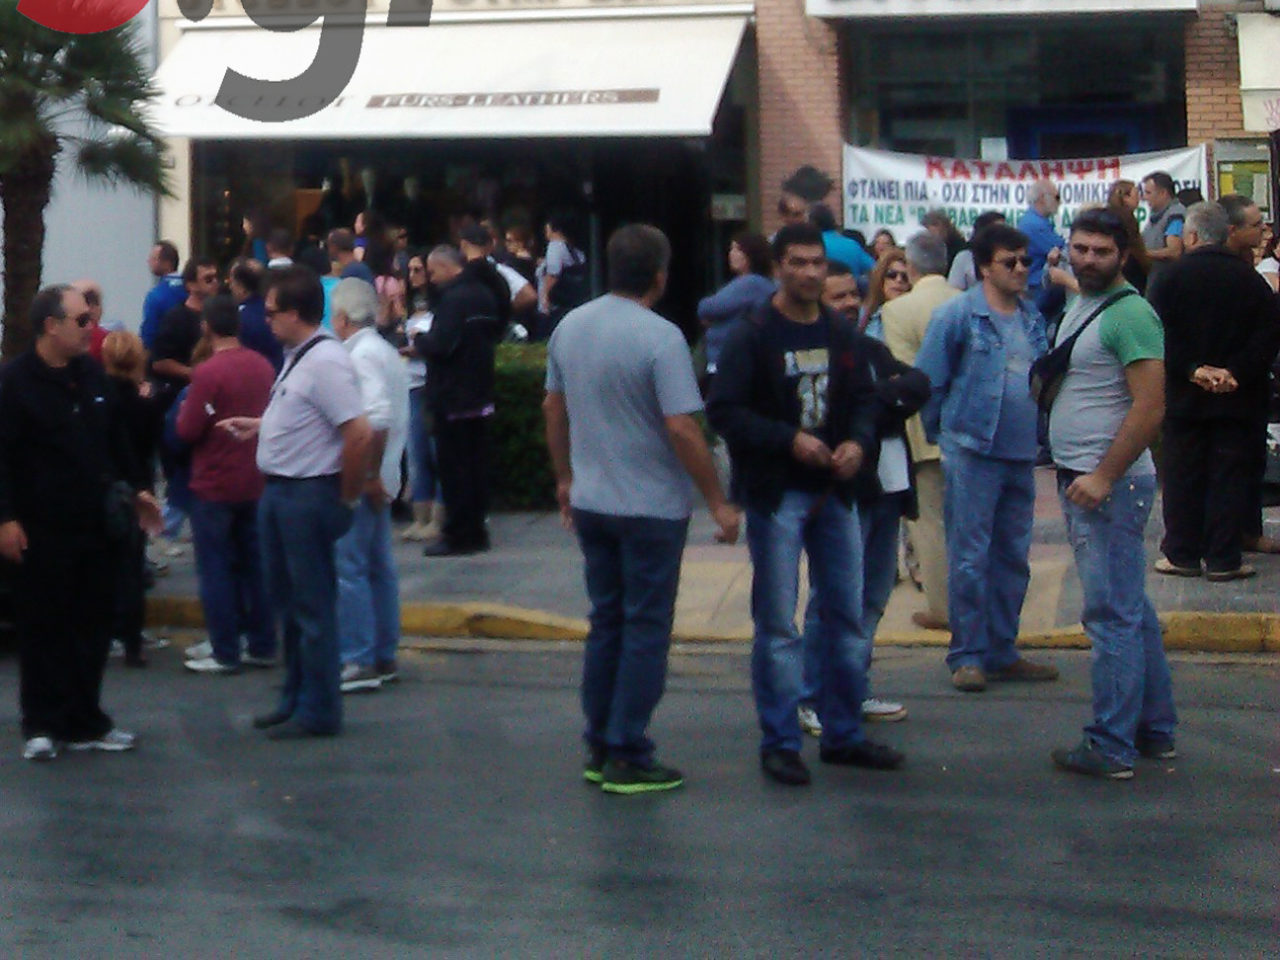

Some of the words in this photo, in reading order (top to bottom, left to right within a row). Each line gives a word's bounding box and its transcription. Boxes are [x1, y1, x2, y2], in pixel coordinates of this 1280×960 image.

[924, 156, 1122, 181] ΚΑΤΑΛΗΨΗ
[847, 179, 899, 201] ΦΤΑΝΕΙ
[904, 182, 929, 201] ΠΙΑ
[942, 183, 966, 203] ΟΧΙ
[971, 183, 1010, 204] ΣΤΗΝ
[849, 205, 869, 224] ΤΑ
[874, 205, 905, 225] ΝΕΑ
